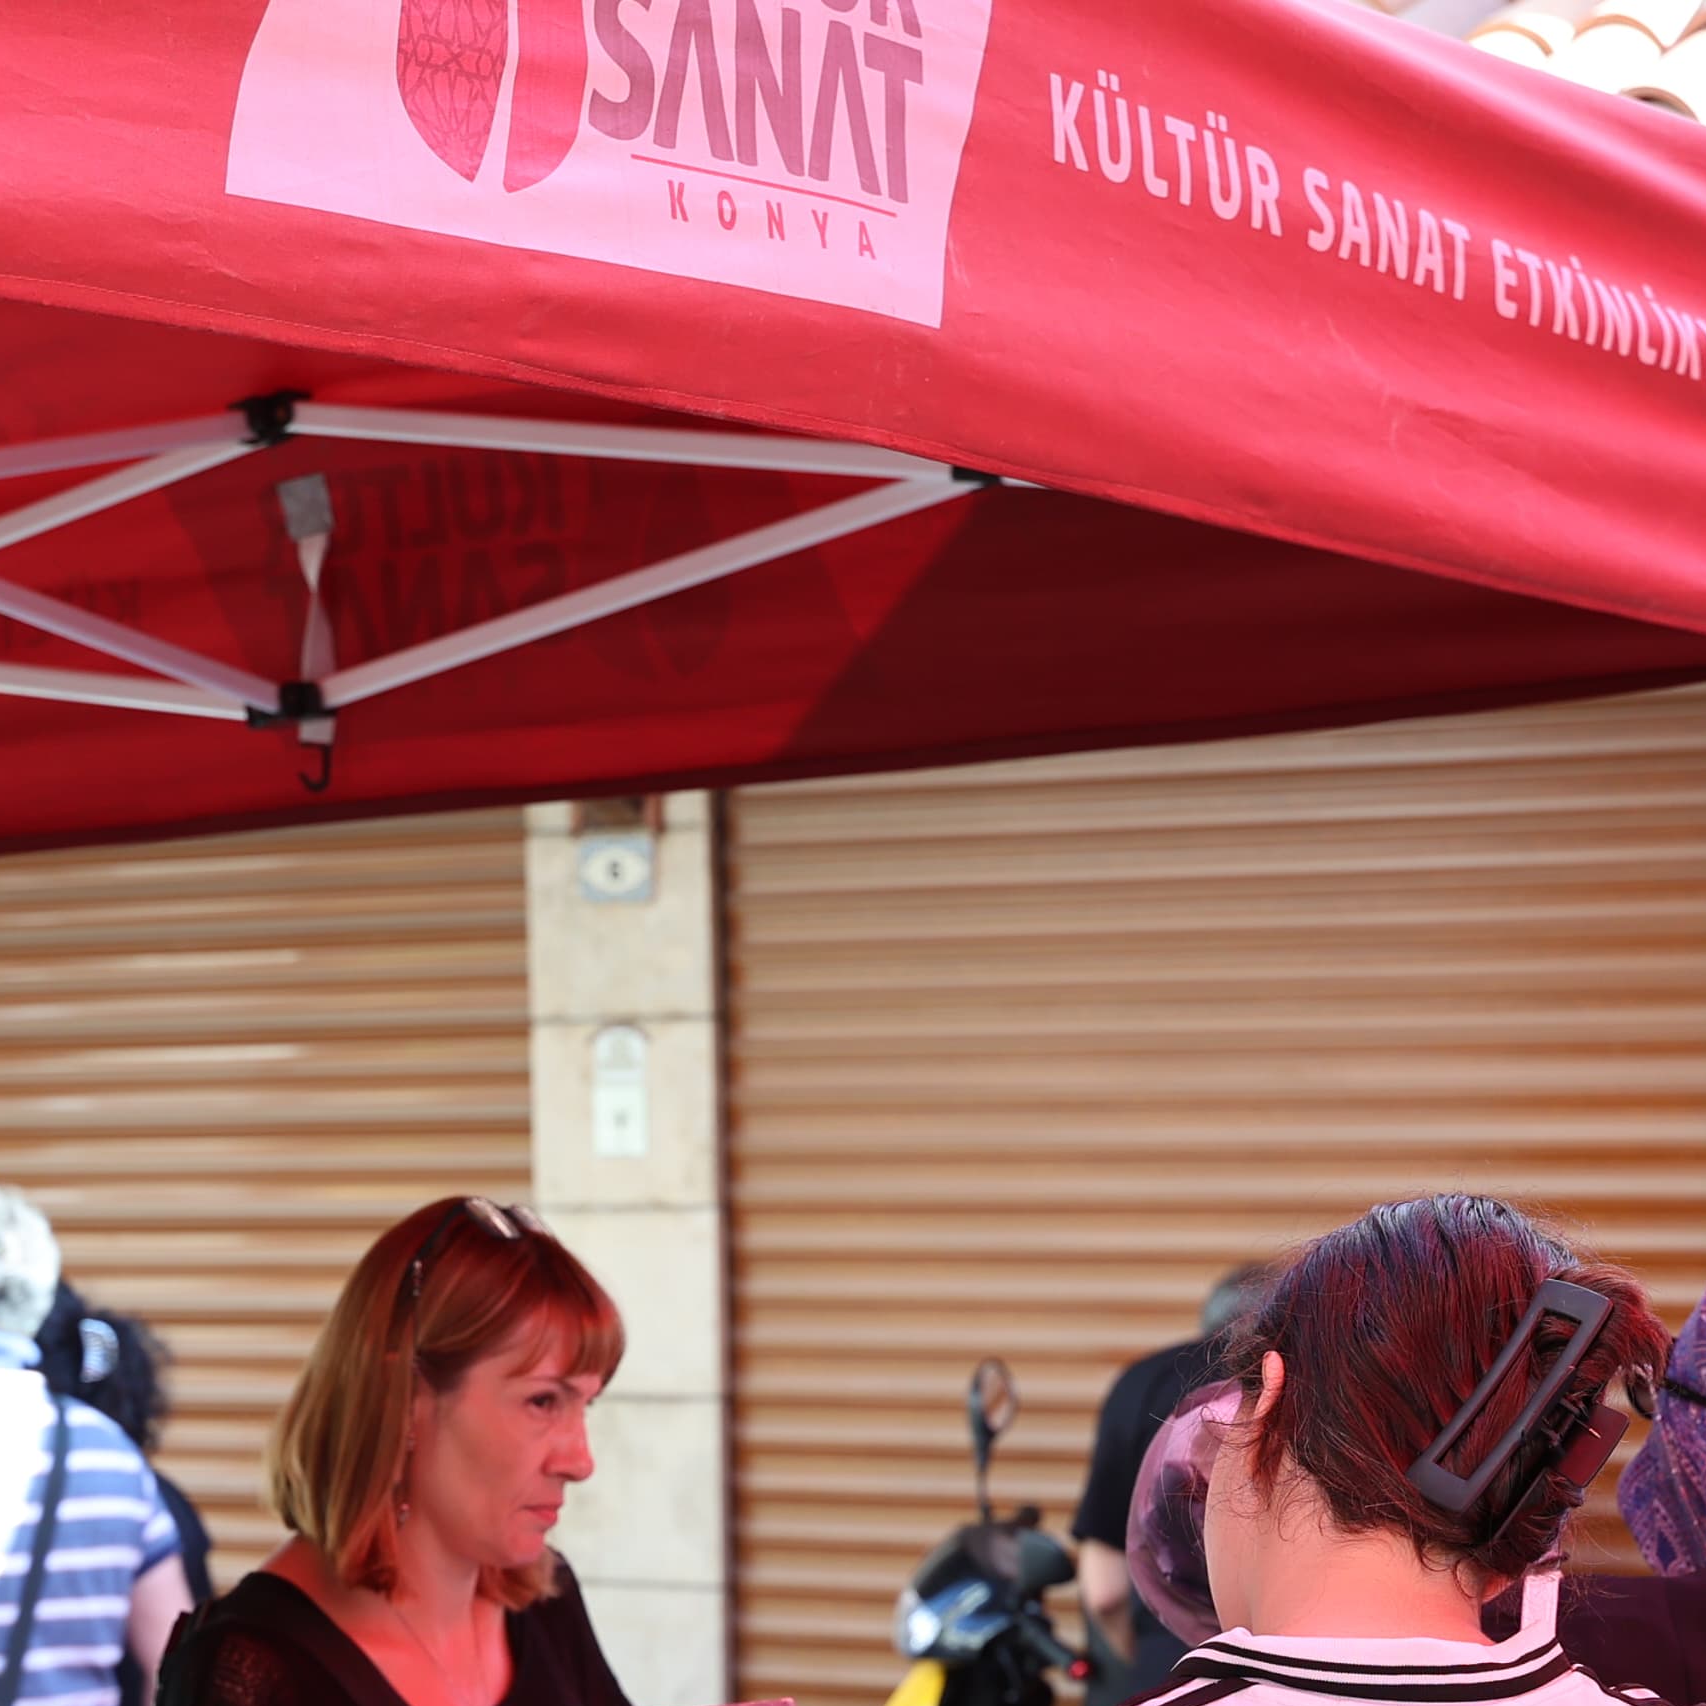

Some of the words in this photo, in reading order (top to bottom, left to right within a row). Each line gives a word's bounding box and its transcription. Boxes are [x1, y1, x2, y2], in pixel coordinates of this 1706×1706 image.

[588, 0, 923, 204] SANAT
[1048, 69, 1283, 236] KÜLTÜR
[1302, 166, 1471, 302] SANAT
[667, 178, 878, 261] KONYA
